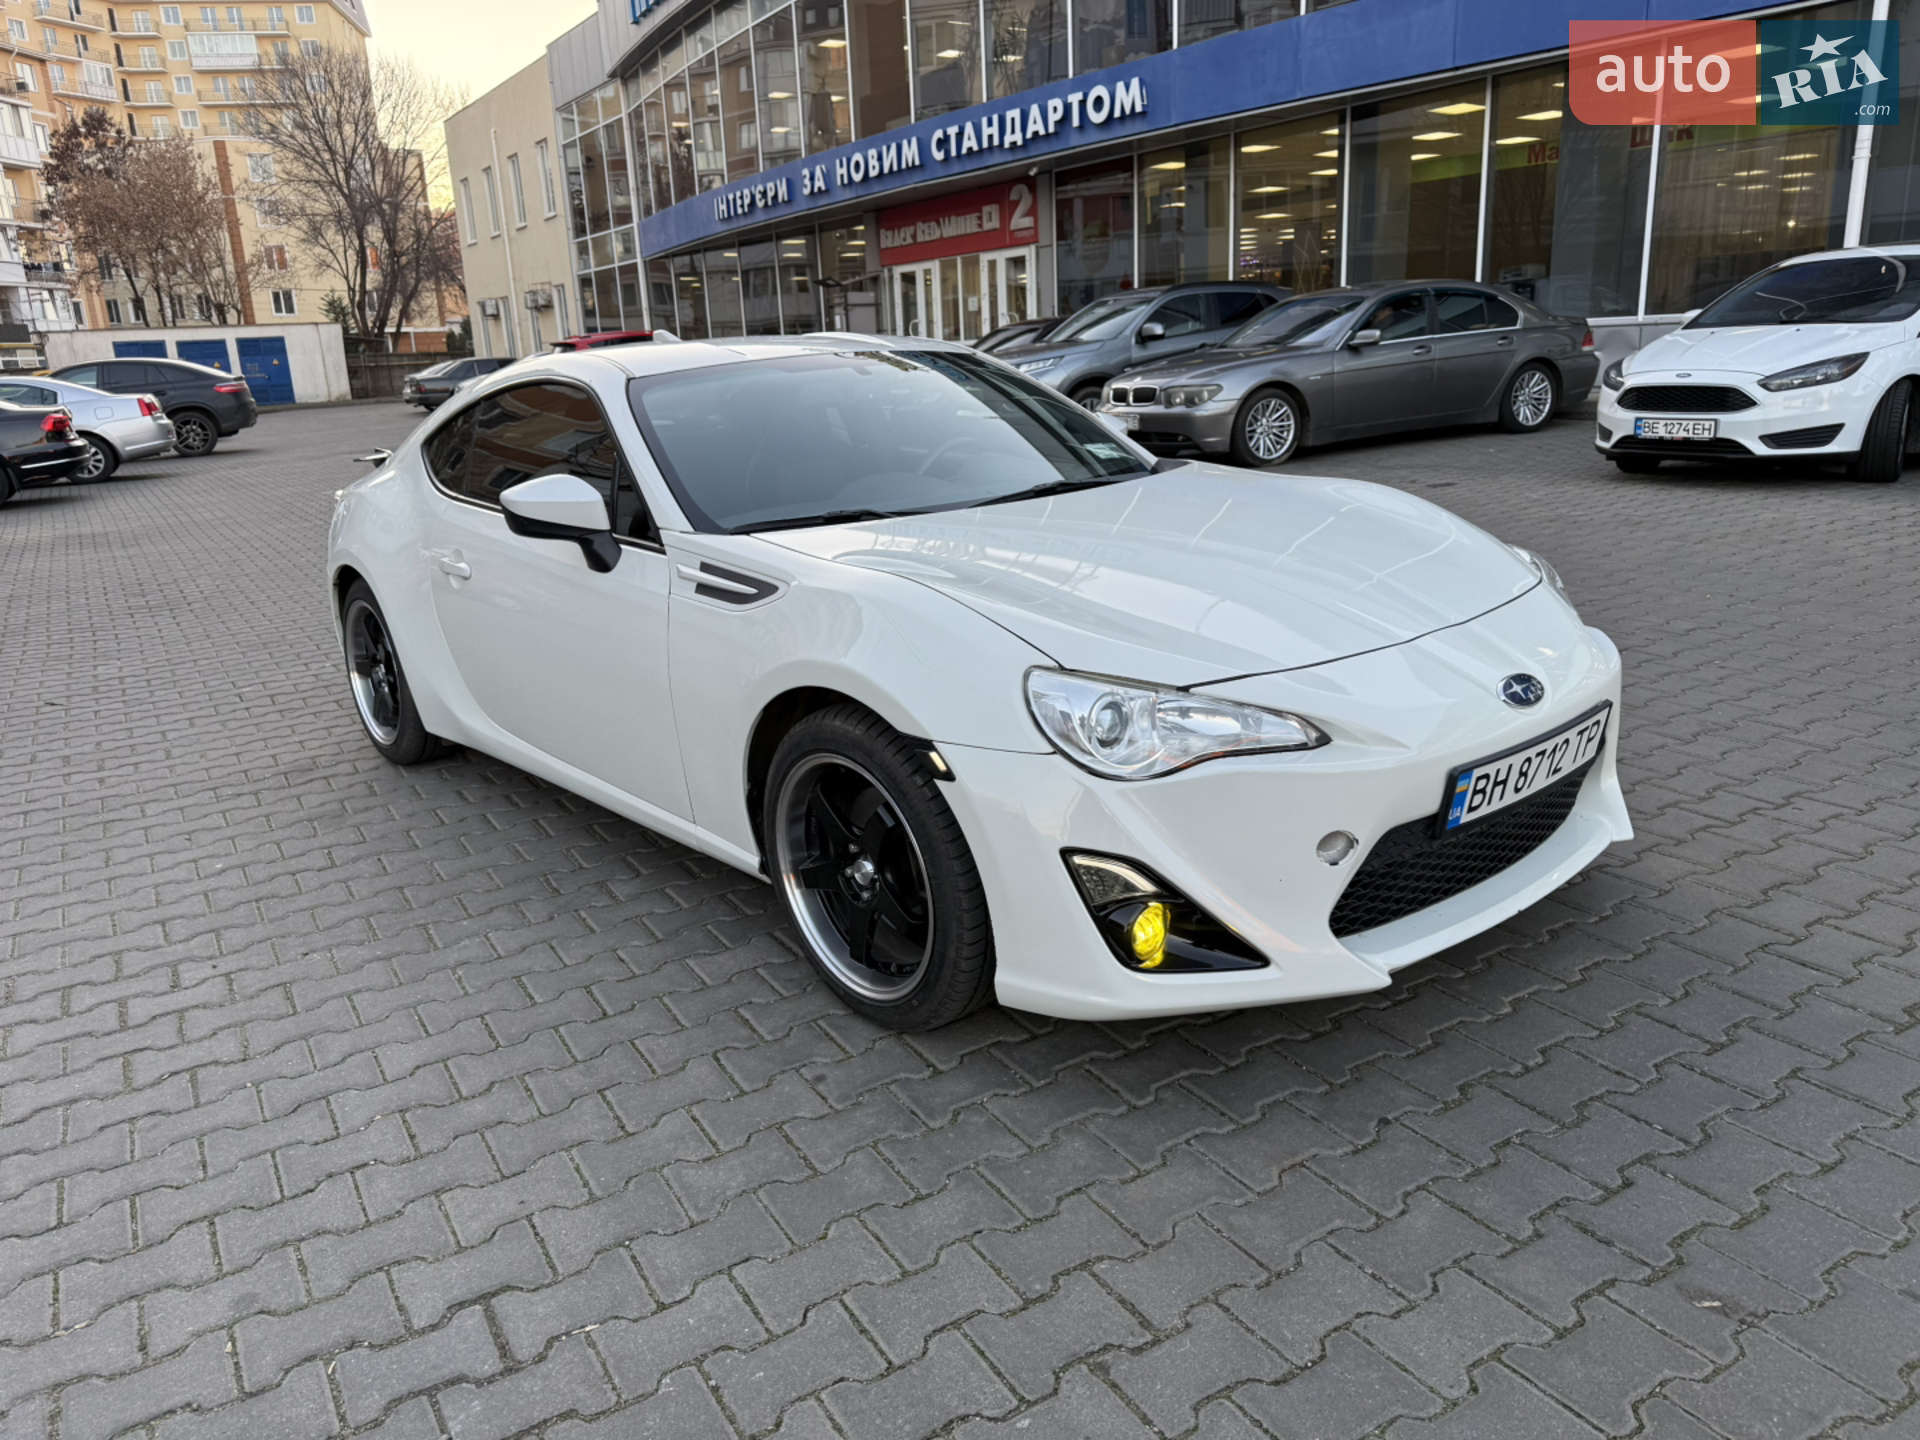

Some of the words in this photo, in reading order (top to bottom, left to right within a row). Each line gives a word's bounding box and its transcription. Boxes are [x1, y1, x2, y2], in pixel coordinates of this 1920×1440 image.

[714, 176, 789, 221] ІНТЕР'ЄРИ
[802, 164, 827, 196] ЗА
[835, 137, 921, 187] НОВИМ
[930, 76, 1144, 162] СТАНДАРТОМ
[1009, 183, 1035, 230] 2
[1643, 421, 1660, 434] BE
[1662, 421, 1691, 435] 1274
[1692, 422, 1713, 436] EH
[1466, 763, 1513, 814] BH
[1513, 737, 1571, 794] 8712
[1572, 719, 1601, 764] TP
[1448, 805, 1461, 820] UA
